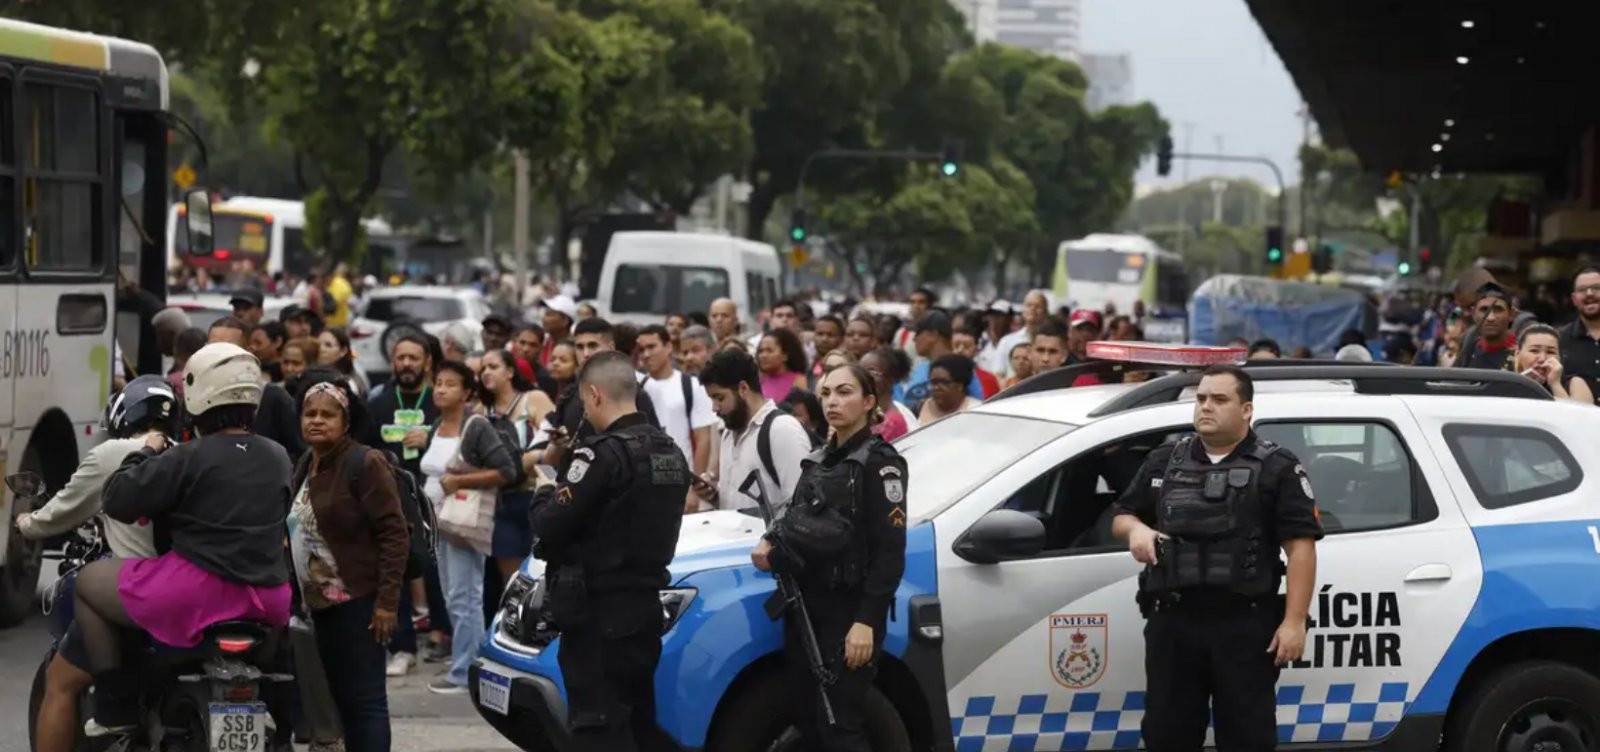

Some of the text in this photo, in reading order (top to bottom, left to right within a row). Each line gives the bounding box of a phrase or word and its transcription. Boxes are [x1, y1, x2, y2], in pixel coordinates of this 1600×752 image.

[1306, 584, 1401, 628] ÍCIA
[1053, 616, 1104, 626] PMERJ
[1280, 633, 1402, 669] ITAR
[223, 715, 254, 732] SSB
